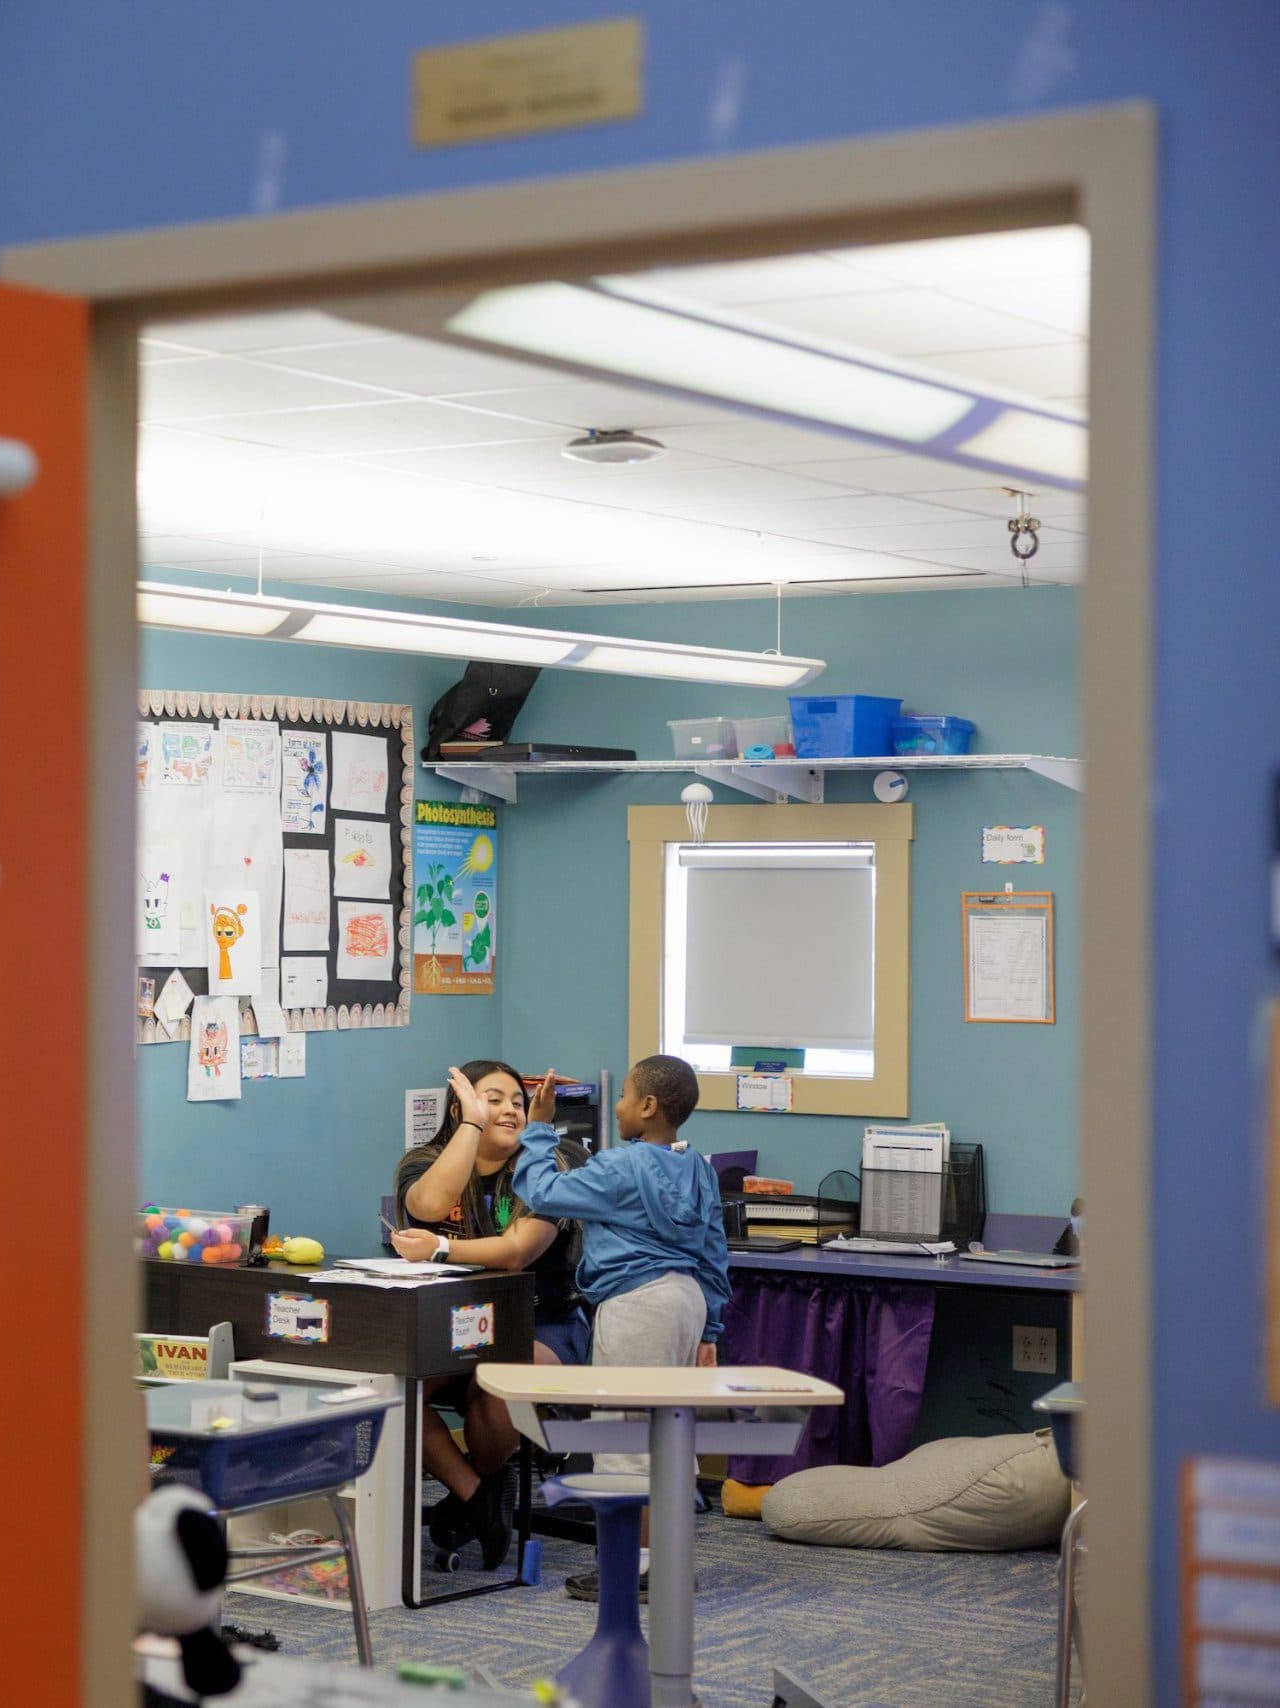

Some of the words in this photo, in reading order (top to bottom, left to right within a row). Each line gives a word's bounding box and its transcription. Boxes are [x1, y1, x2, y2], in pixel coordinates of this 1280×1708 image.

[417, 803, 496, 827] Photosynthesis
[986, 833, 1004, 843] Daily
[273, 1303, 301, 1313] Teacher
[272, 1314, 291, 1325] Desk
[455, 1315, 476, 1324] Teacher
[157, 1344, 208, 1361] IVAN
